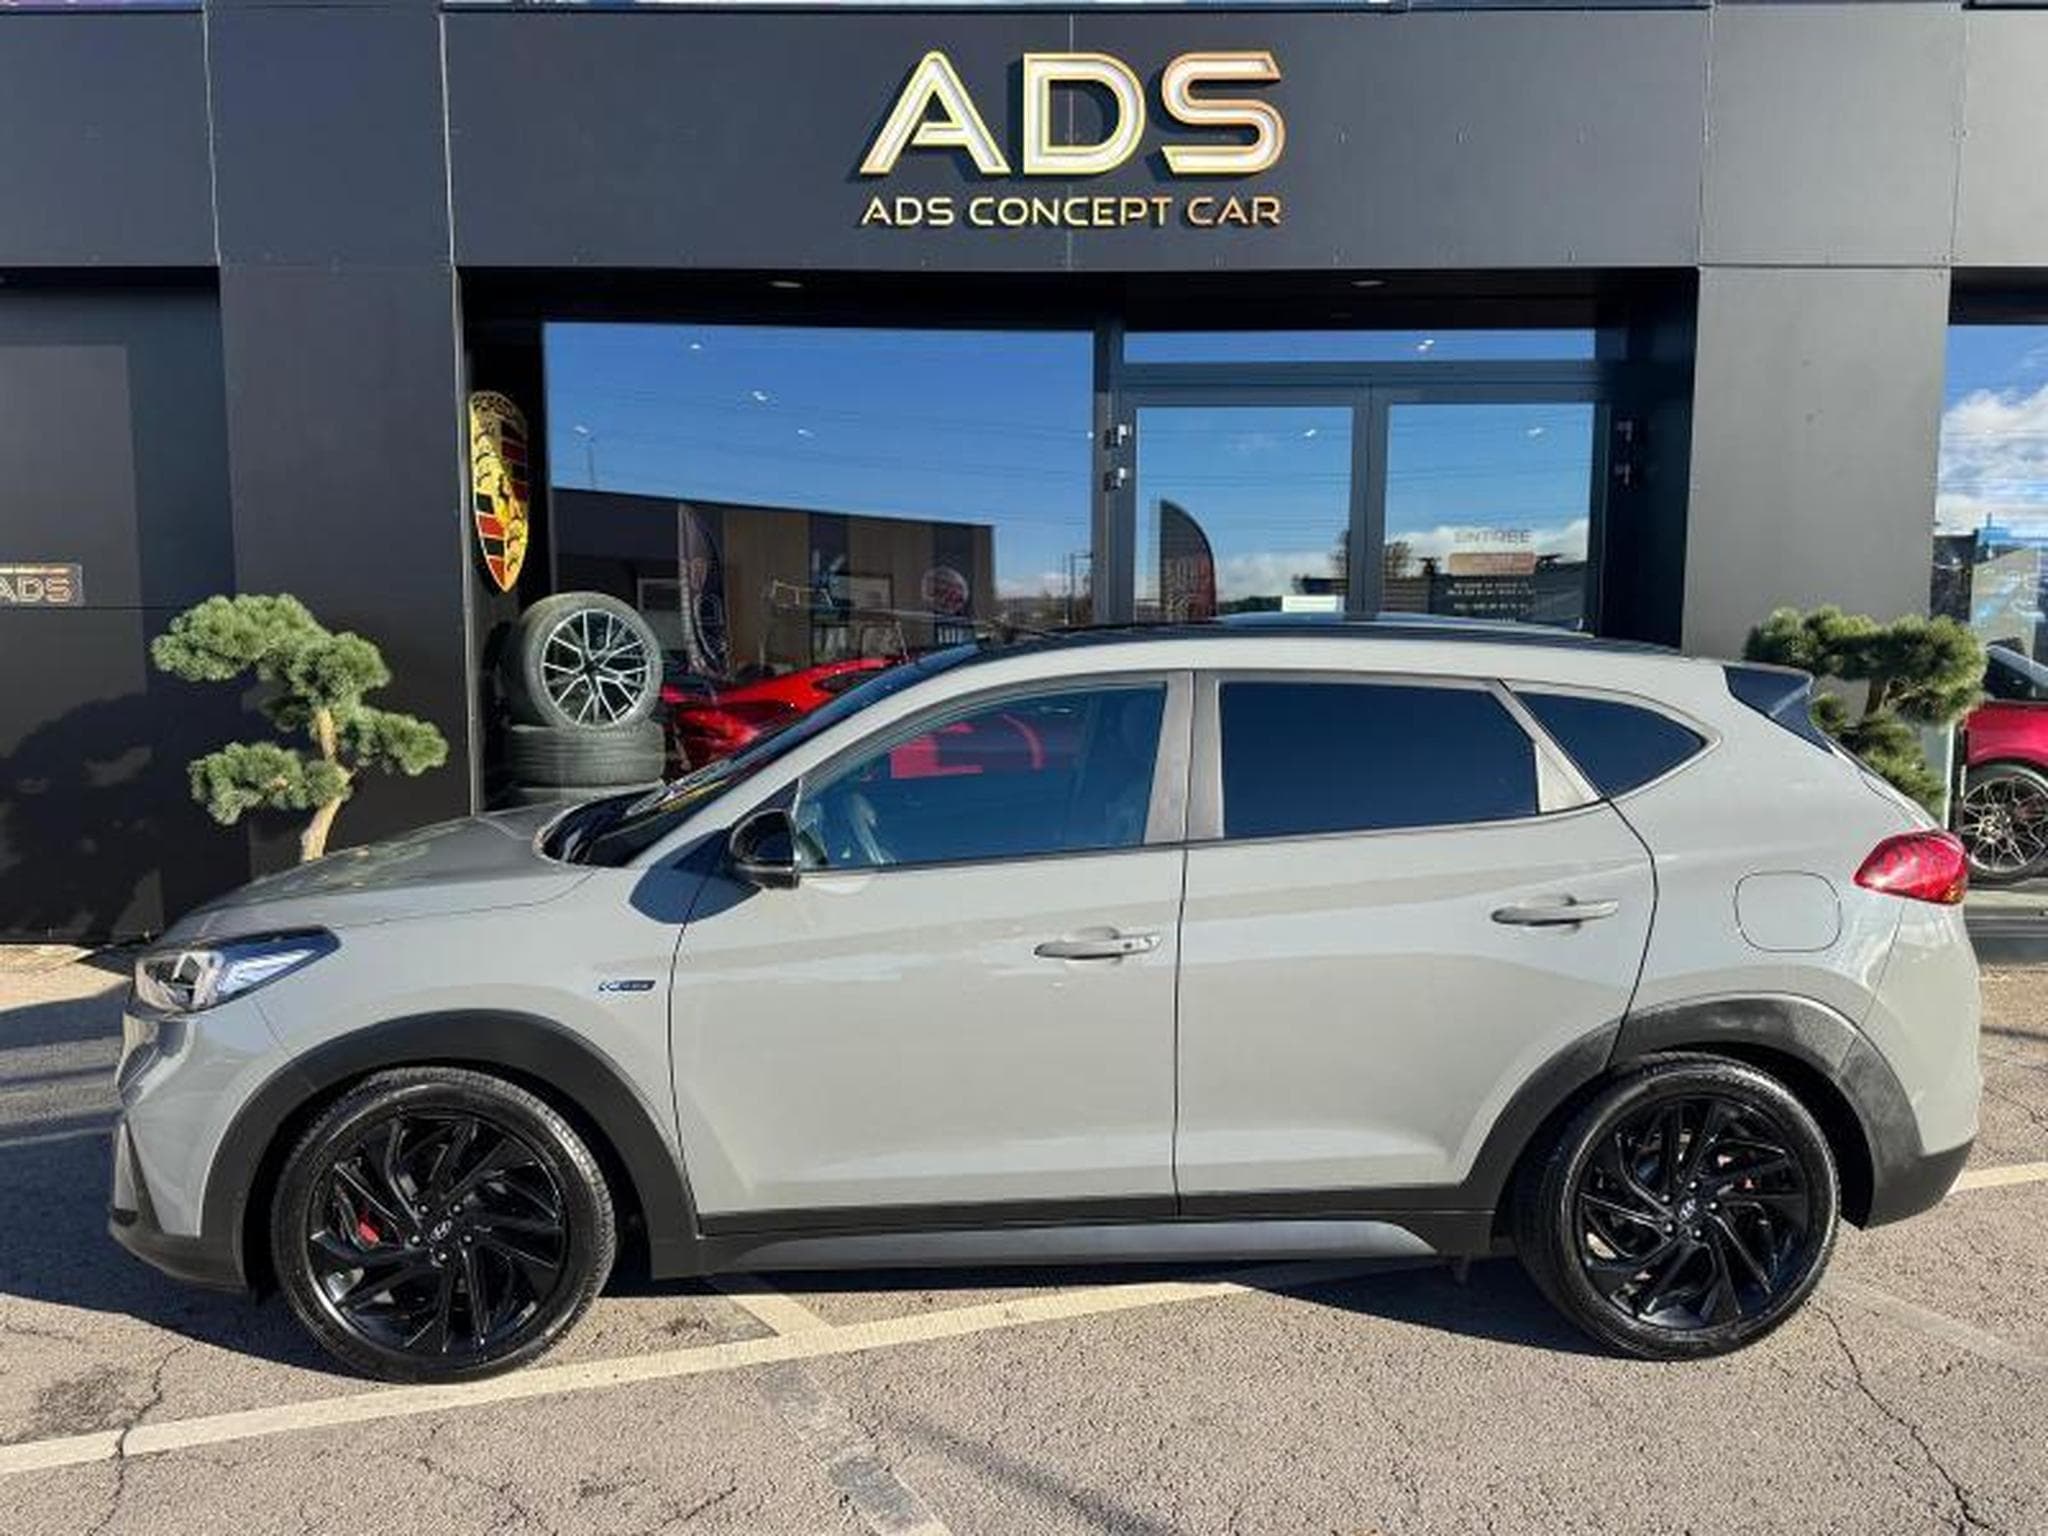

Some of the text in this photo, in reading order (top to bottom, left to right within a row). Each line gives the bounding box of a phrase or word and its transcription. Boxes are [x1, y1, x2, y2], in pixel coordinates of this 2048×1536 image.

[859, 49, 1287, 175] ADS
[862, 196, 1282, 226] ADS CONCEPT CAR
